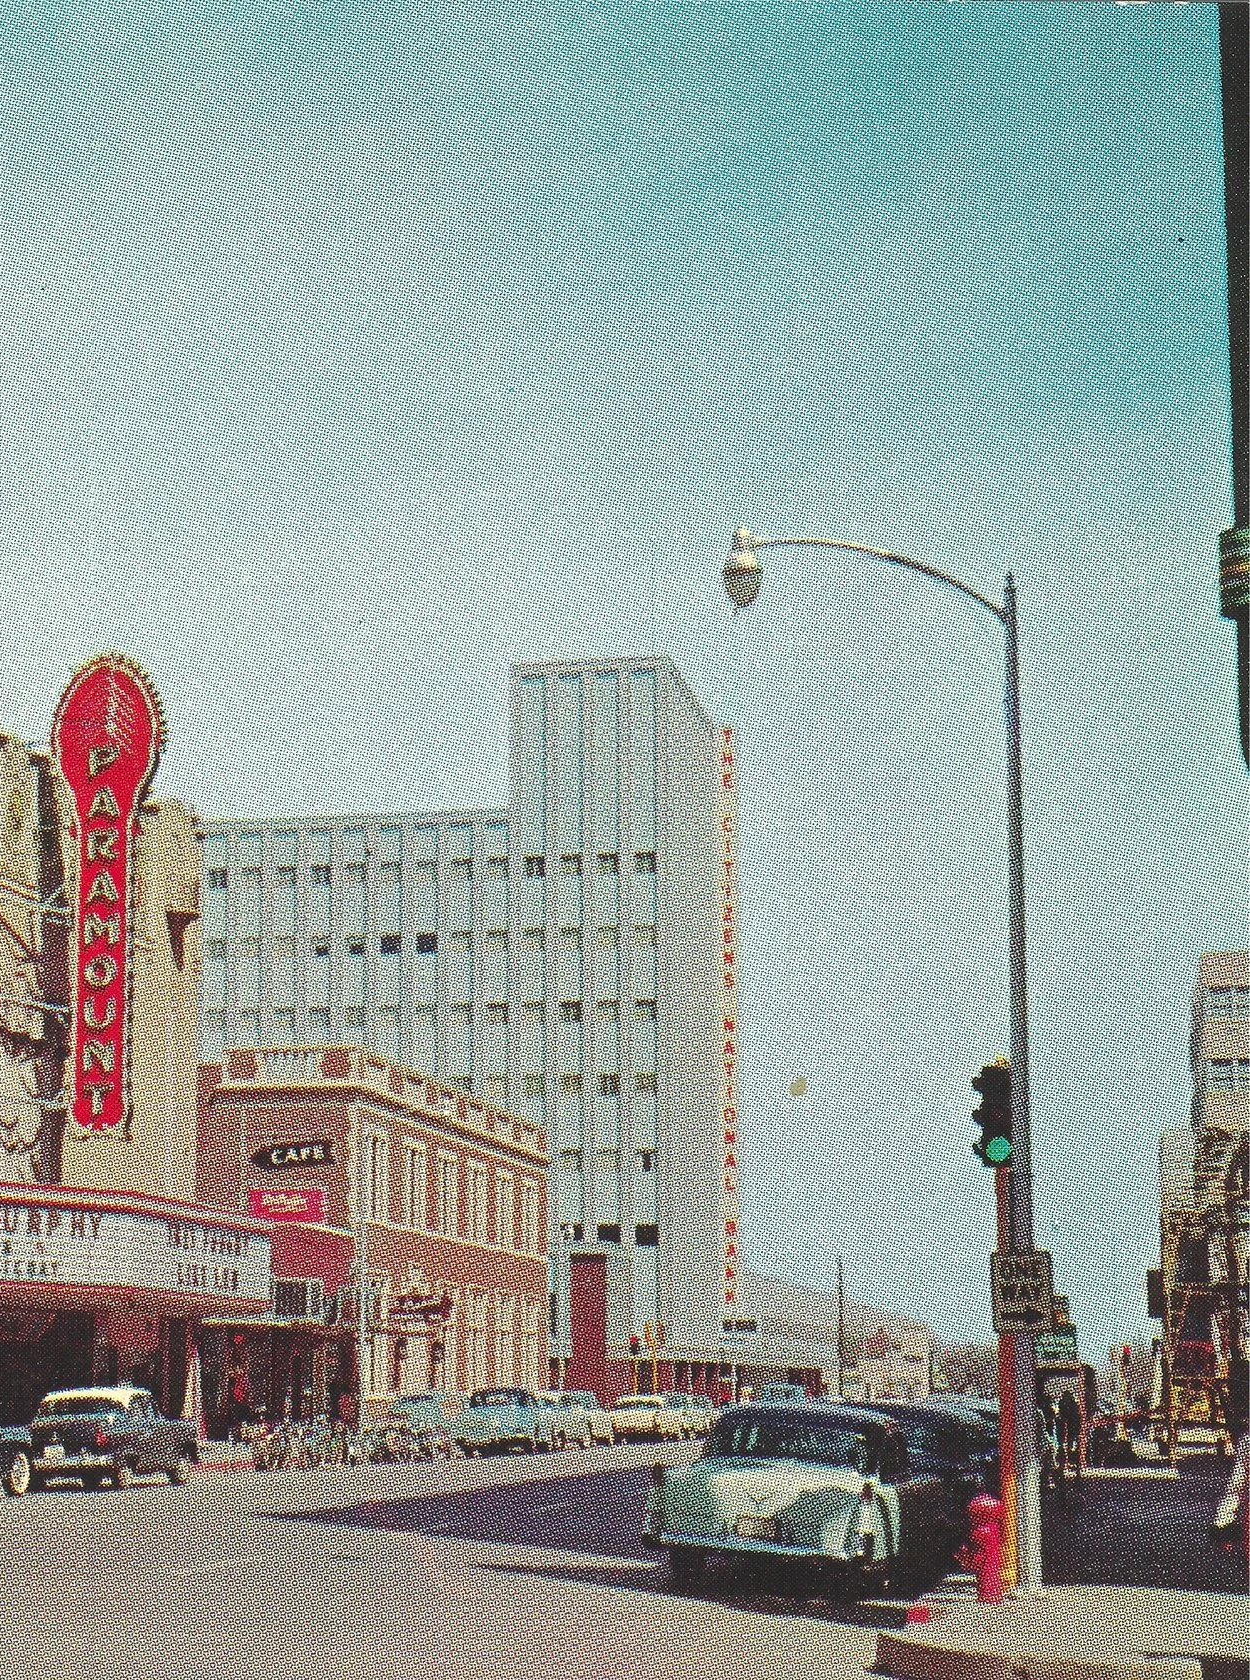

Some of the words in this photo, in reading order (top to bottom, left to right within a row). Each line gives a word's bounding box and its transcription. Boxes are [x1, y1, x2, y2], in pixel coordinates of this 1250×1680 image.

[721, 727, 734, 789] THE
[83, 745, 121, 1116] PARAMOUNT
[721, 816, 735, 989] CITIZENS
[723, 1018, 736, 1192] NATIONAL
[271, 1144, 325, 1165] CAFE
[999, 1281, 1044, 1301] WAY
[1000, 1259, 1043, 1280] ONE
